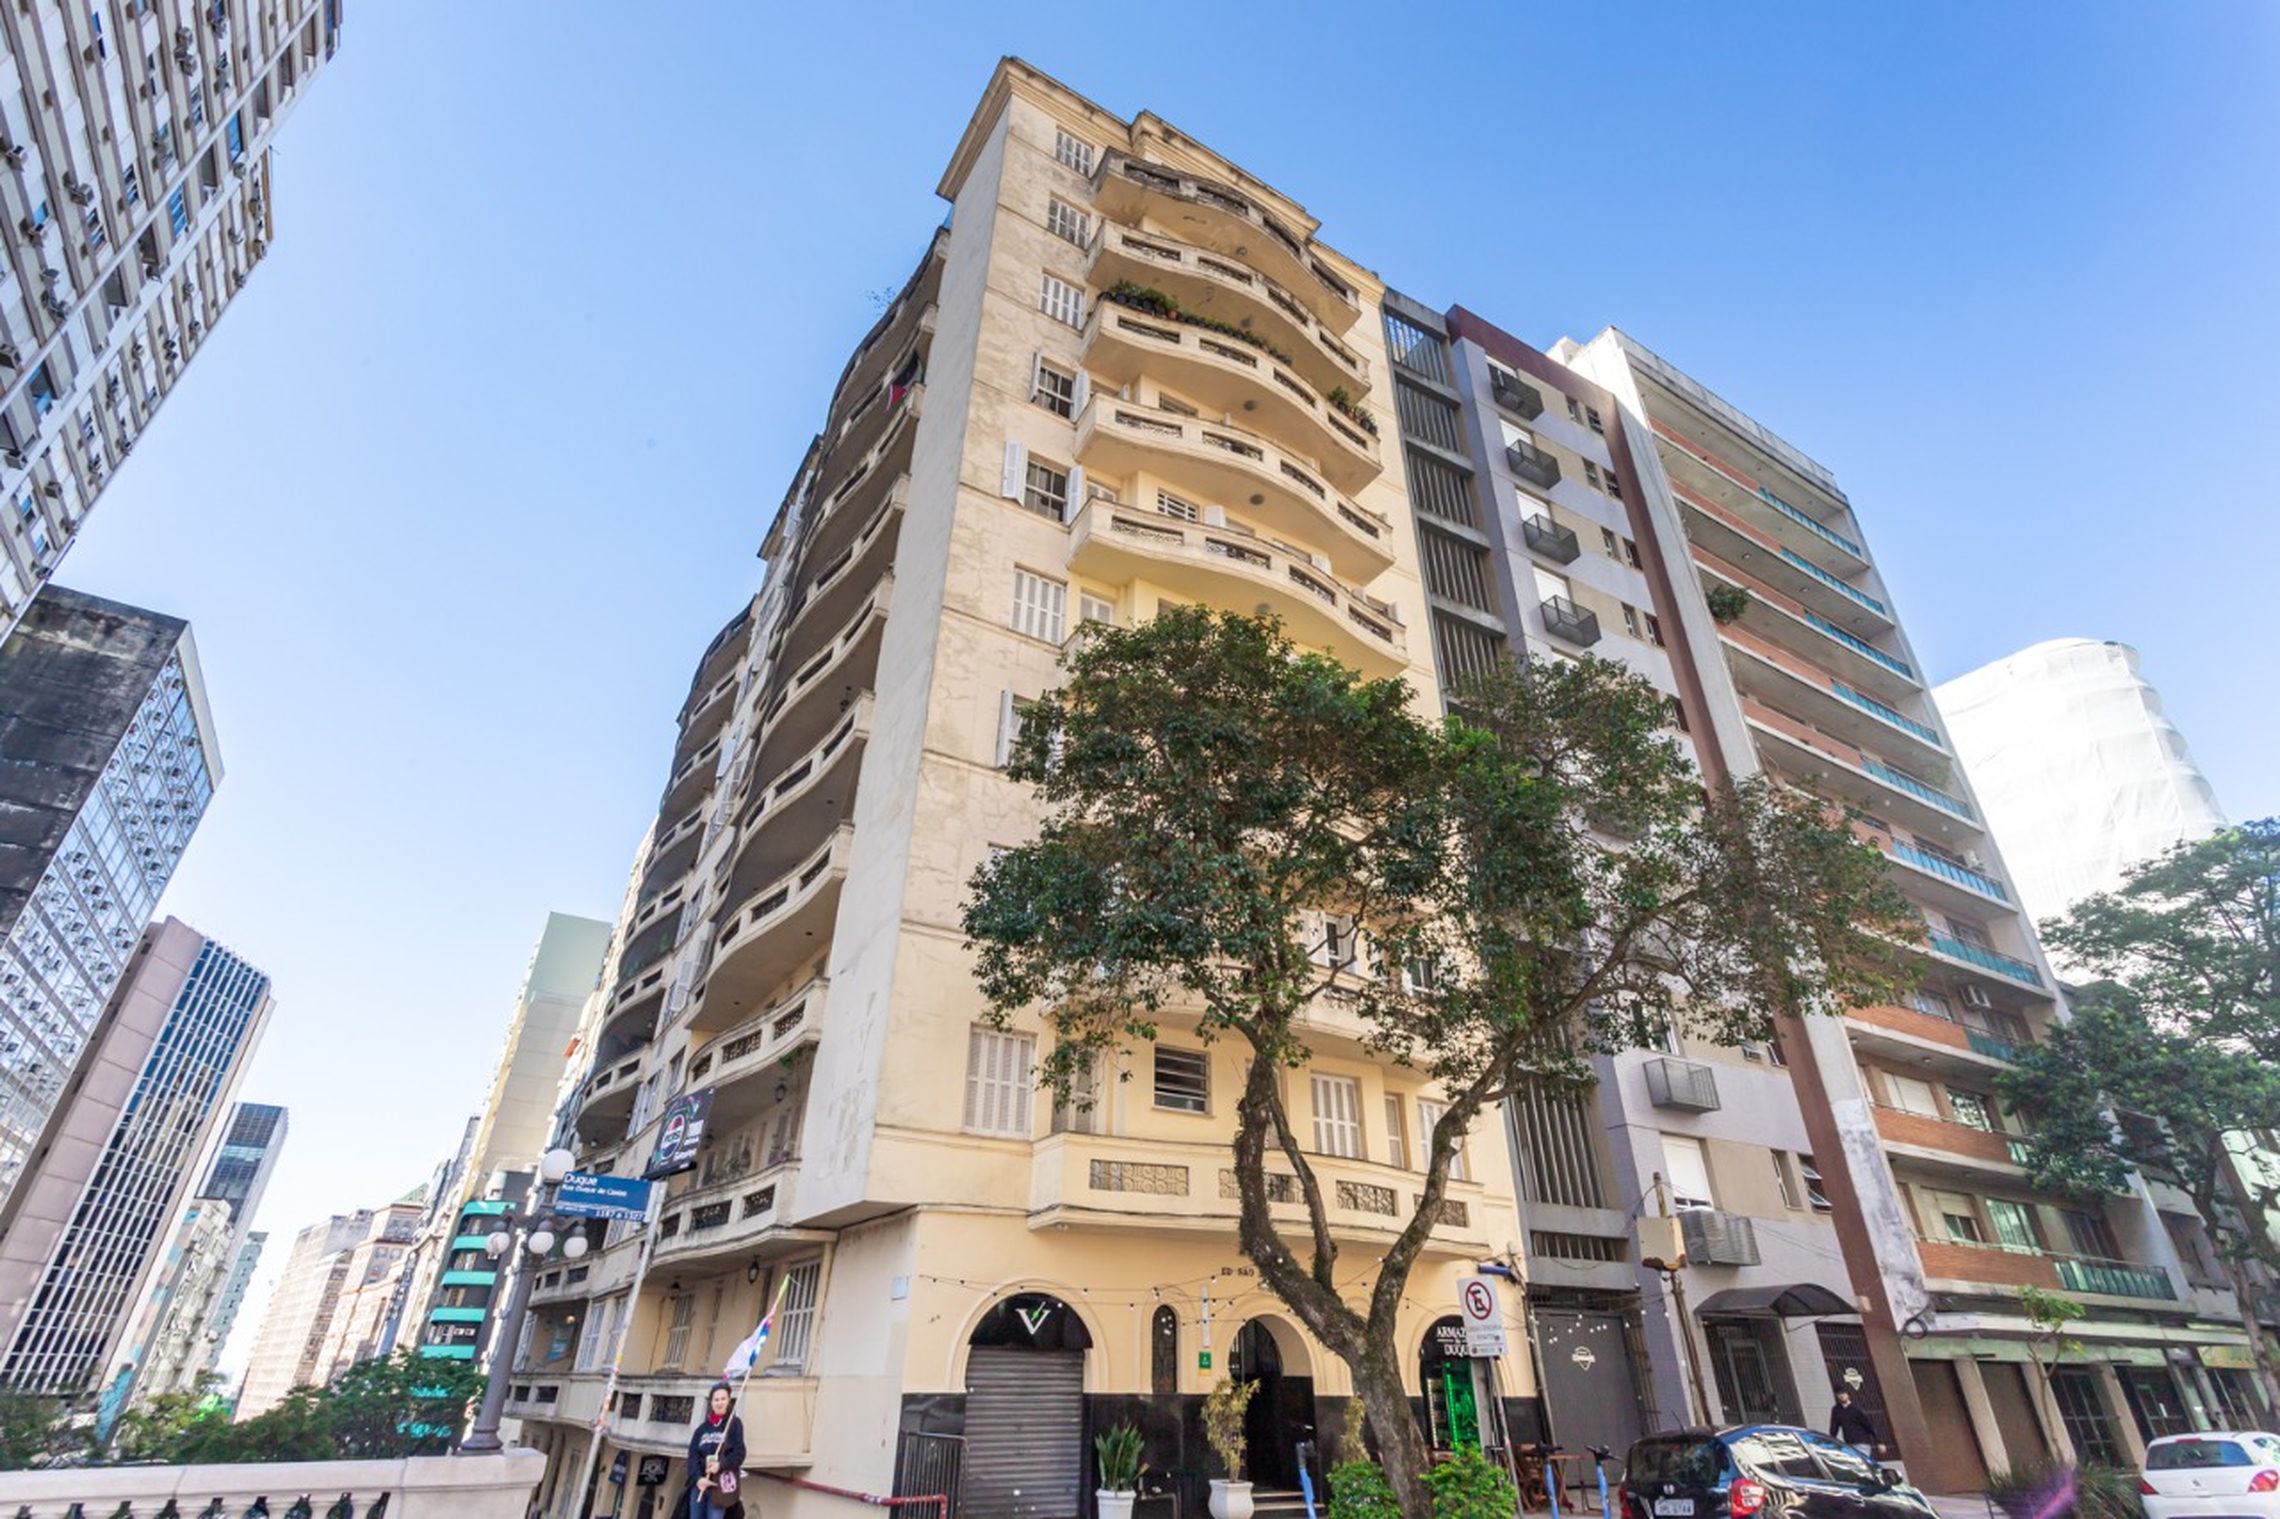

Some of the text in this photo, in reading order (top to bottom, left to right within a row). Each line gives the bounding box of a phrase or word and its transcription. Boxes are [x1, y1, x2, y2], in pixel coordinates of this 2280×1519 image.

[564, 1173, 598, 1185] Duque
[1436, 1326, 1467, 1338] ARMAZ
[1444, 1344, 1470, 1357] DUQU
